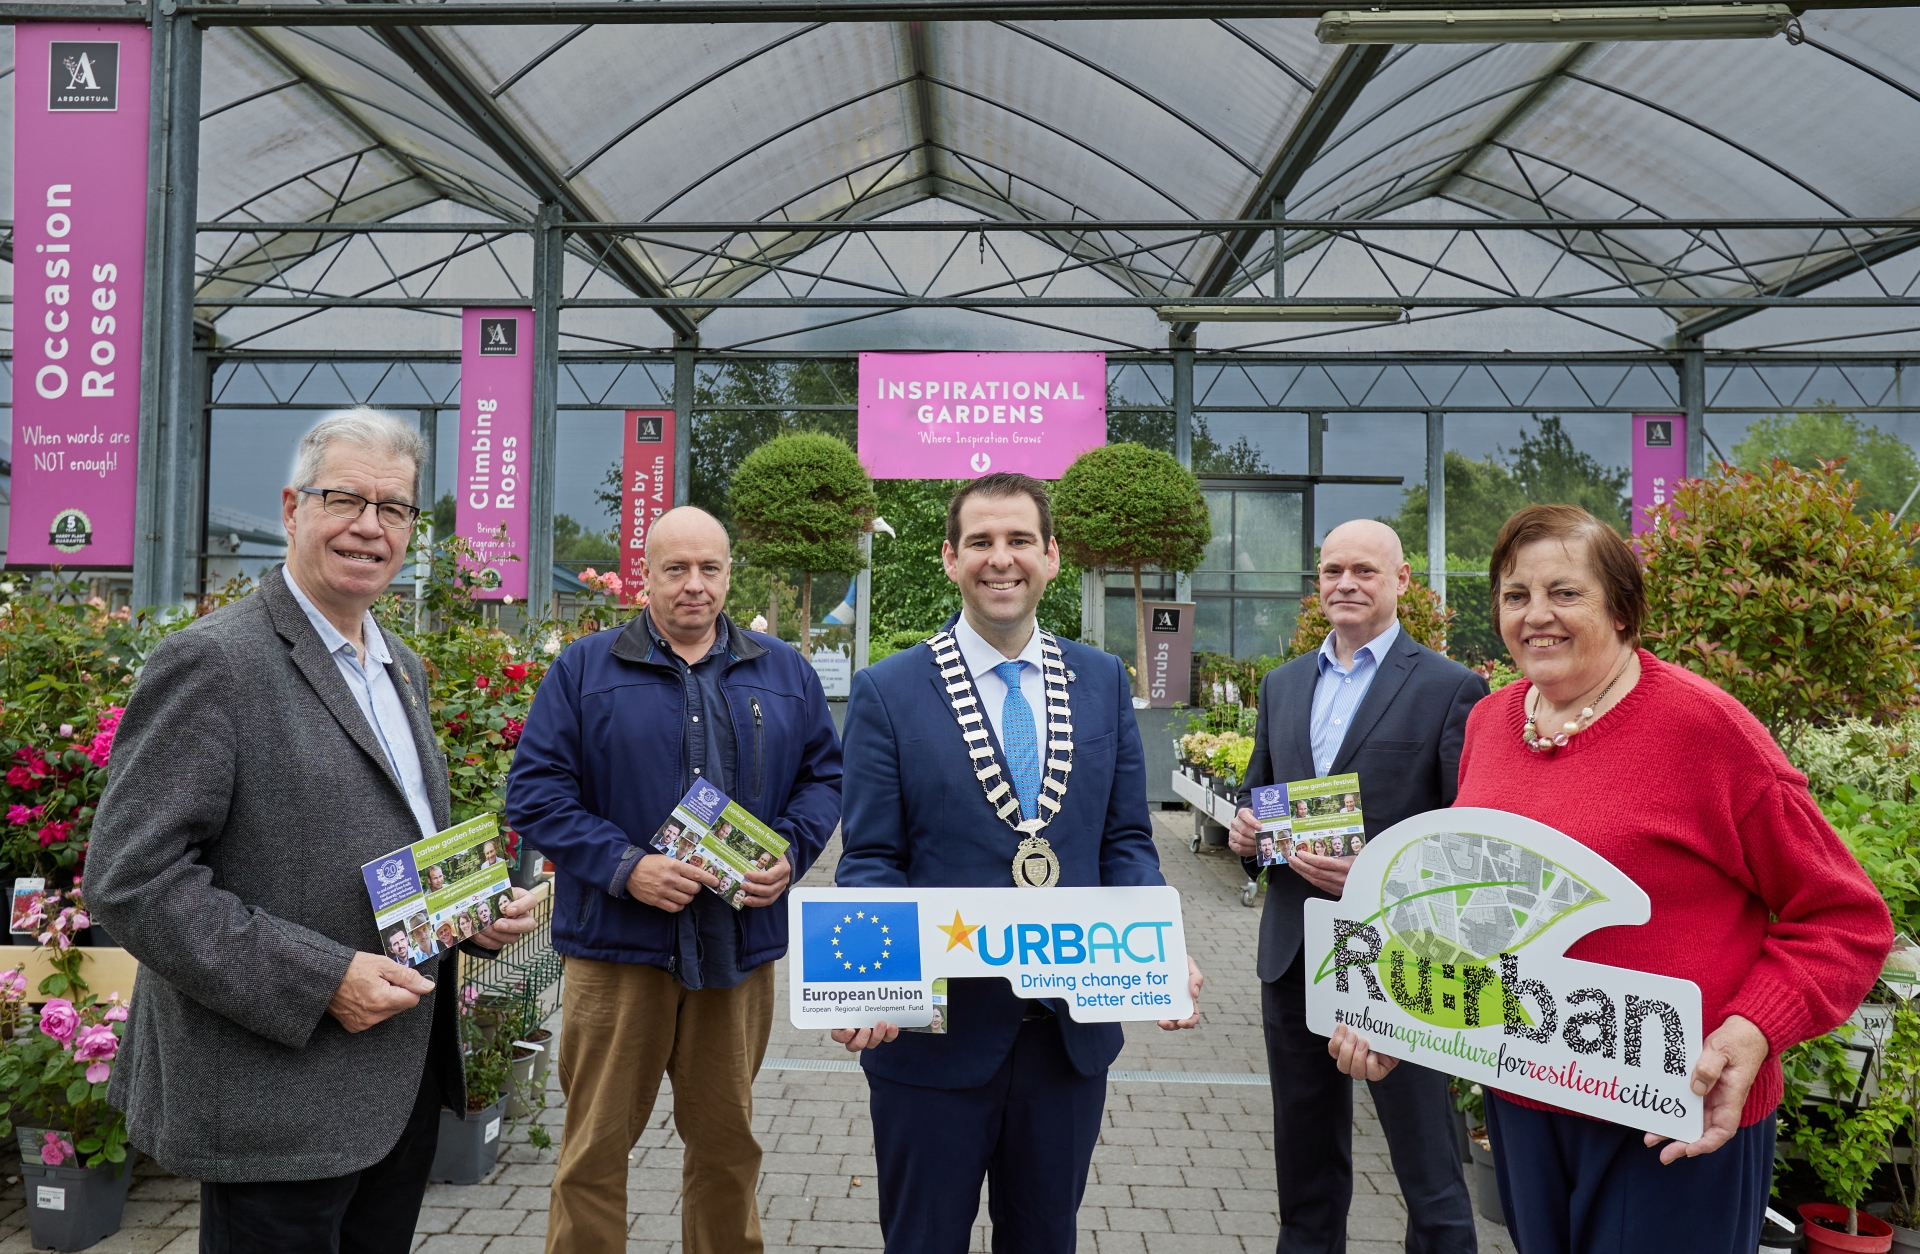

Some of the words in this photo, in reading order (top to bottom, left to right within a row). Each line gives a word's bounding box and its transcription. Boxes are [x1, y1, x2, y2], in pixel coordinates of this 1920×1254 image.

[35, 184, 72, 400] Occasion
[81, 262, 118, 398] Roses
[878, 378, 1084, 400] INSPIRATIONAL
[917, 405, 1043, 424] GARDENS
[22, 425, 61, 446] When
[66, 425, 104, 444] words
[110, 432, 130, 444] are
[956, 431, 1008, 448] Inspiration
[34, 452, 65, 471] NOT
[70, 451, 117, 478] enough!
[469, 398, 497, 510] Climbing
[496, 436, 517, 508] Roses
[632, 470, 648, 492] by
[652, 455, 664, 502] Austin
[67, 516, 76, 528] 5
[630, 498, 645, 549] Roses
[1151, 642, 1169, 698] Shrubs
[1310, 782, 1332, 791] garden
[1333, 778, 1357, 786] festival
[416, 842, 441, 858] carlow
[442, 831, 468, 848] garden
[468, 819, 495, 835] festival
[727, 806, 746, 820] carlow
[745, 818, 765, 836] garden
[765, 832, 785, 850] festival
[385, 865, 396, 876] 20
[977, 921, 1173, 966] URBACT
[1021, 974, 1076, 990] Driving
[1081, 973, 1141, 989] change
[1146, 972, 1168, 985] for
[803, 987, 876, 1002] European
[878, 986, 923, 1000] Union
[1076, 992, 1127, 1007] better
[1132, 991, 1171, 1005] cities
[835, 1005, 861, 1013] Regional
[865, 1004, 905, 1013] Development
[1335, 1008, 1687, 1118] #urbanagricultureforresilientcities
